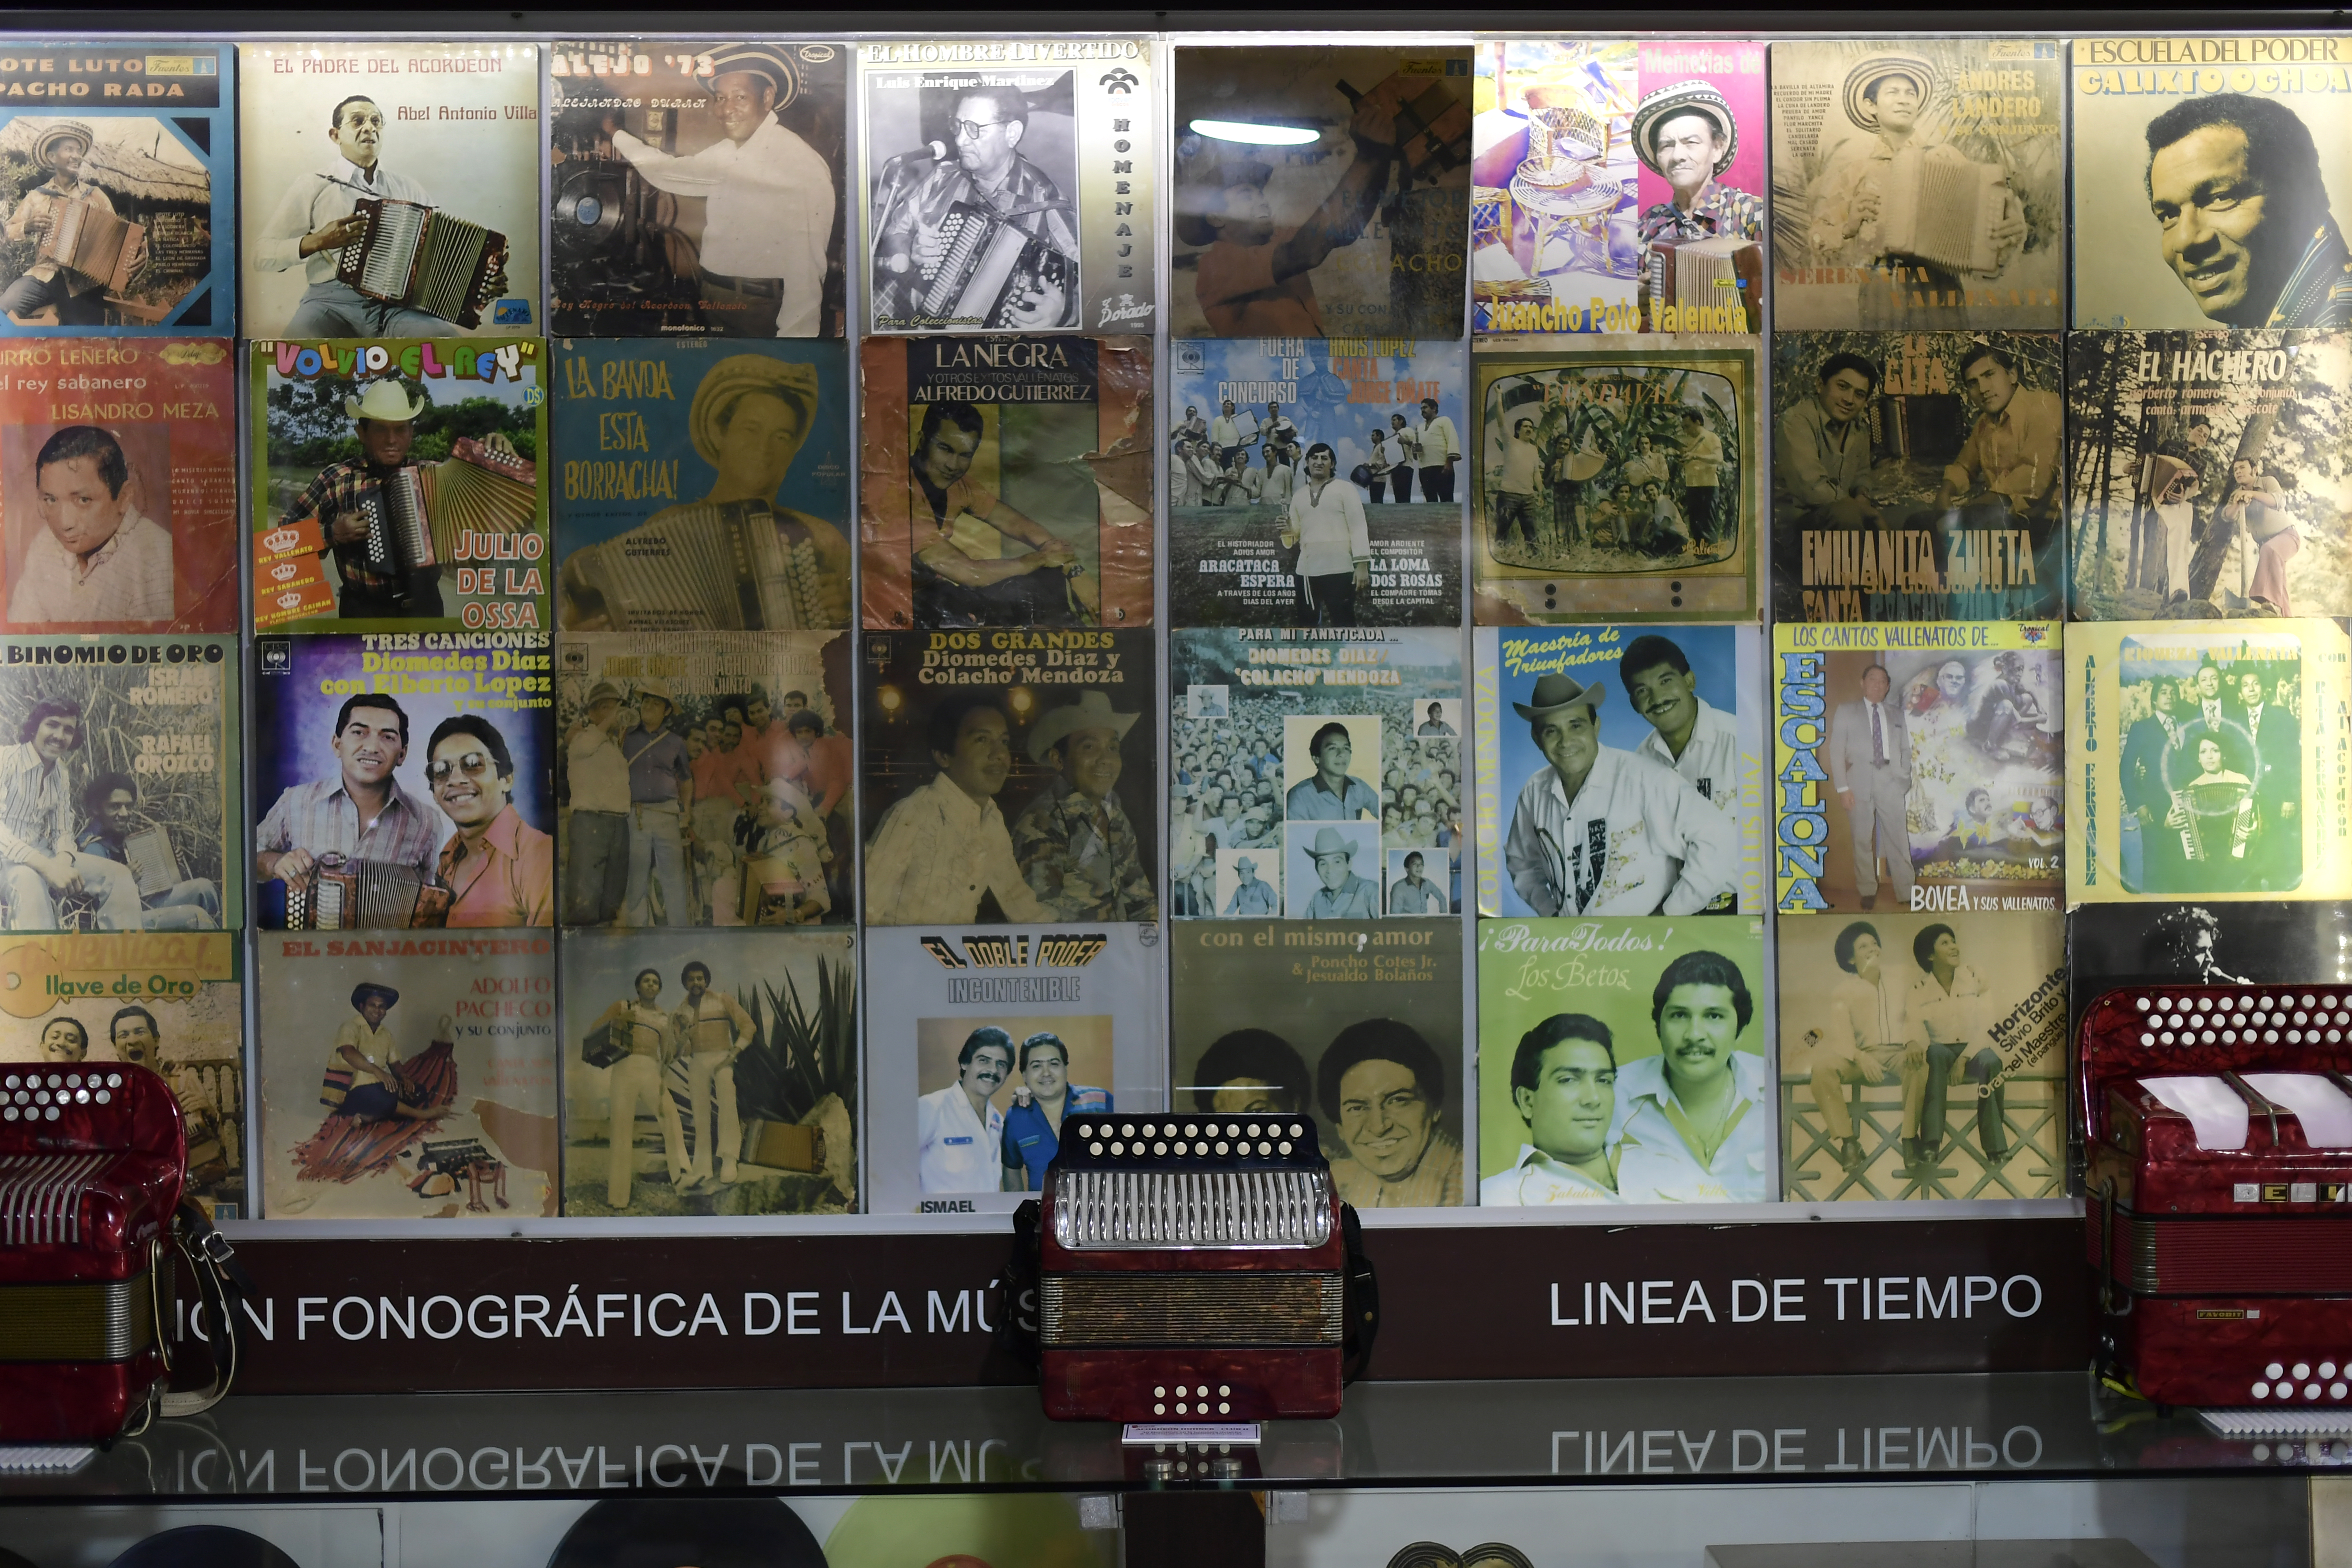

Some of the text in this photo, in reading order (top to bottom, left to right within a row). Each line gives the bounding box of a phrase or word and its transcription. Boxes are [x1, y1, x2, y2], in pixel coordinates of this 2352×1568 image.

[803, 49, 832, 60] Tropical
[867, 41, 1139, 63] EL HOMBRE DIVERTIDO
[1992, 45, 2031, 58] Fuentes
[2090, 39, 2338, 63] ESCUELA DEL PODER
[69, 58, 143, 72] LUTO
[150, 60, 189, 72] Fuentes
[273, 58, 502, 73] EL PADRE DEL ACORDEON
[552, 55, 652, 77] ALEJO
[1645, 49, 1762, 74] Memorias de
[104, 82, 184, 97] RADA
[876, 75, 1054, 90] Luis Enrique Martinez
[1958, 70, 2035, 91] ANDRES
[2079, 67, 2352, 95] CALIXTO OCHOA
[397, 105, 537, 120] Abel Antonio Villa
[1953, 97, 2041, 118] LANDERO
[878, 315, 984, 327] Para Coleccionistas
[1489, 297, 1747, 332] Juancho Polo Valencia
[936, 343, 1068, 368] LA NEGRA
[1282, 358, 1299, 380] DE
[1333, 358, 1379, 380] CANTA
[2139, 350, 2287, 382] EL HACHERO
[17, 376, 147, 394] rey sabanero
[564, 356, 676, 401] LA BANDA
[914, 384, 1091, 401] ALFREDO GUTIERREZ
[1218, 381, 1297, 404] CONCURSO
[1347, 381, 1391, 404] JORGE
[52, 403, 220, 420] LISANDRO MEZA
[599, 411, 649, 452] ESTA
[455, 530, 544, 561] JULIO
[1199, 560, 1280, 572] ARACATACA
[1370, 558, 1430, 571] LA LOMA
[1948, 530, 2036, 585] ZULETA
[457, 568, 545, 595] DE LA
[1241, 575, 1295, 587] ESPERA
[1371, 574, 1442, 587] DOS ROSAS
[462, 602, 539, 629] OSSA
[1239, 629, 1385, 641] PARA MI FANATICADA
[1598, 626, 1620, 643] de
[1793, 627, 1966, 647] LOS CANTOS VALLENATOS
[2018, 623, 2050, 633] Tropical
[362, 632, 550, 651] TRES CANCIONES
[929, 632, 1114, 649] DOS GRANDES
[7, 644, 224, 664] BINOMIO DE ORO
[362, 650, 551, 672] Diomedes Diaz
[923, 650, 1098, 667] Diomedes Diaz
[1248, 649, 1331, 664] DIOMEDES
[1505, 647, 1623, 677] Triunfadores
[149, 668, 216, 687] ISRAEL
[320, 673, 551, 695] con Elberto Lopez
[918, 668, 1124, 684] Colacho Mendoza
[1325, 669, 1402, 686] MENDOZA
[130, 687, 214, 705] ROMERO
[142, 735, 214, 754] RAFAEL
[134, 754, 214, 773] OROZCO
[2085, 655, 2097, 885] ALBERTO FERNANDEZ
[1475, 665, 1498, 913] COLACHO MENDOZA
[1742, 752, 1762, 910] IVO LUIS DIAZ
[2028, 856, 2059, 869] VOL. 2
[1910, 885, 1998, 912] BOVEA Y SUS
[1200, 932, 1243, 947] con
[1253, 926, 1274, 946] el
[1372, 931, 1433, 945] amor
[282, 939, 550, 957] EL SANJACINTERO
[921, 934, 1107, 969] EL DOBLE PODER
[1311, 954, 1437, 968] Poncho Cotes Jr.
[46, 974, 194, 995] llave de Oro
[1307, 969, 1368, 983] Jesualdo
[1505, 952, 1632, 1001] Los Betos
[470, 978, 551, 995] ADOLFO
[948, 977, 1080, 1003] INCONTENIBLE
[456, 1001, 551, 1018] PACHECO
[1987, 967, 2067, 1043] Horizonte
[1999, 997, 2060, 1053] Silvio Brito
[920, 1201, 975, 1213] ISMAEL
[1550, 1274, 2042, 1325] LINEA DE TIEMPO
[298, 1284, 912, 1340] FONOGRÁFICA DE LA
